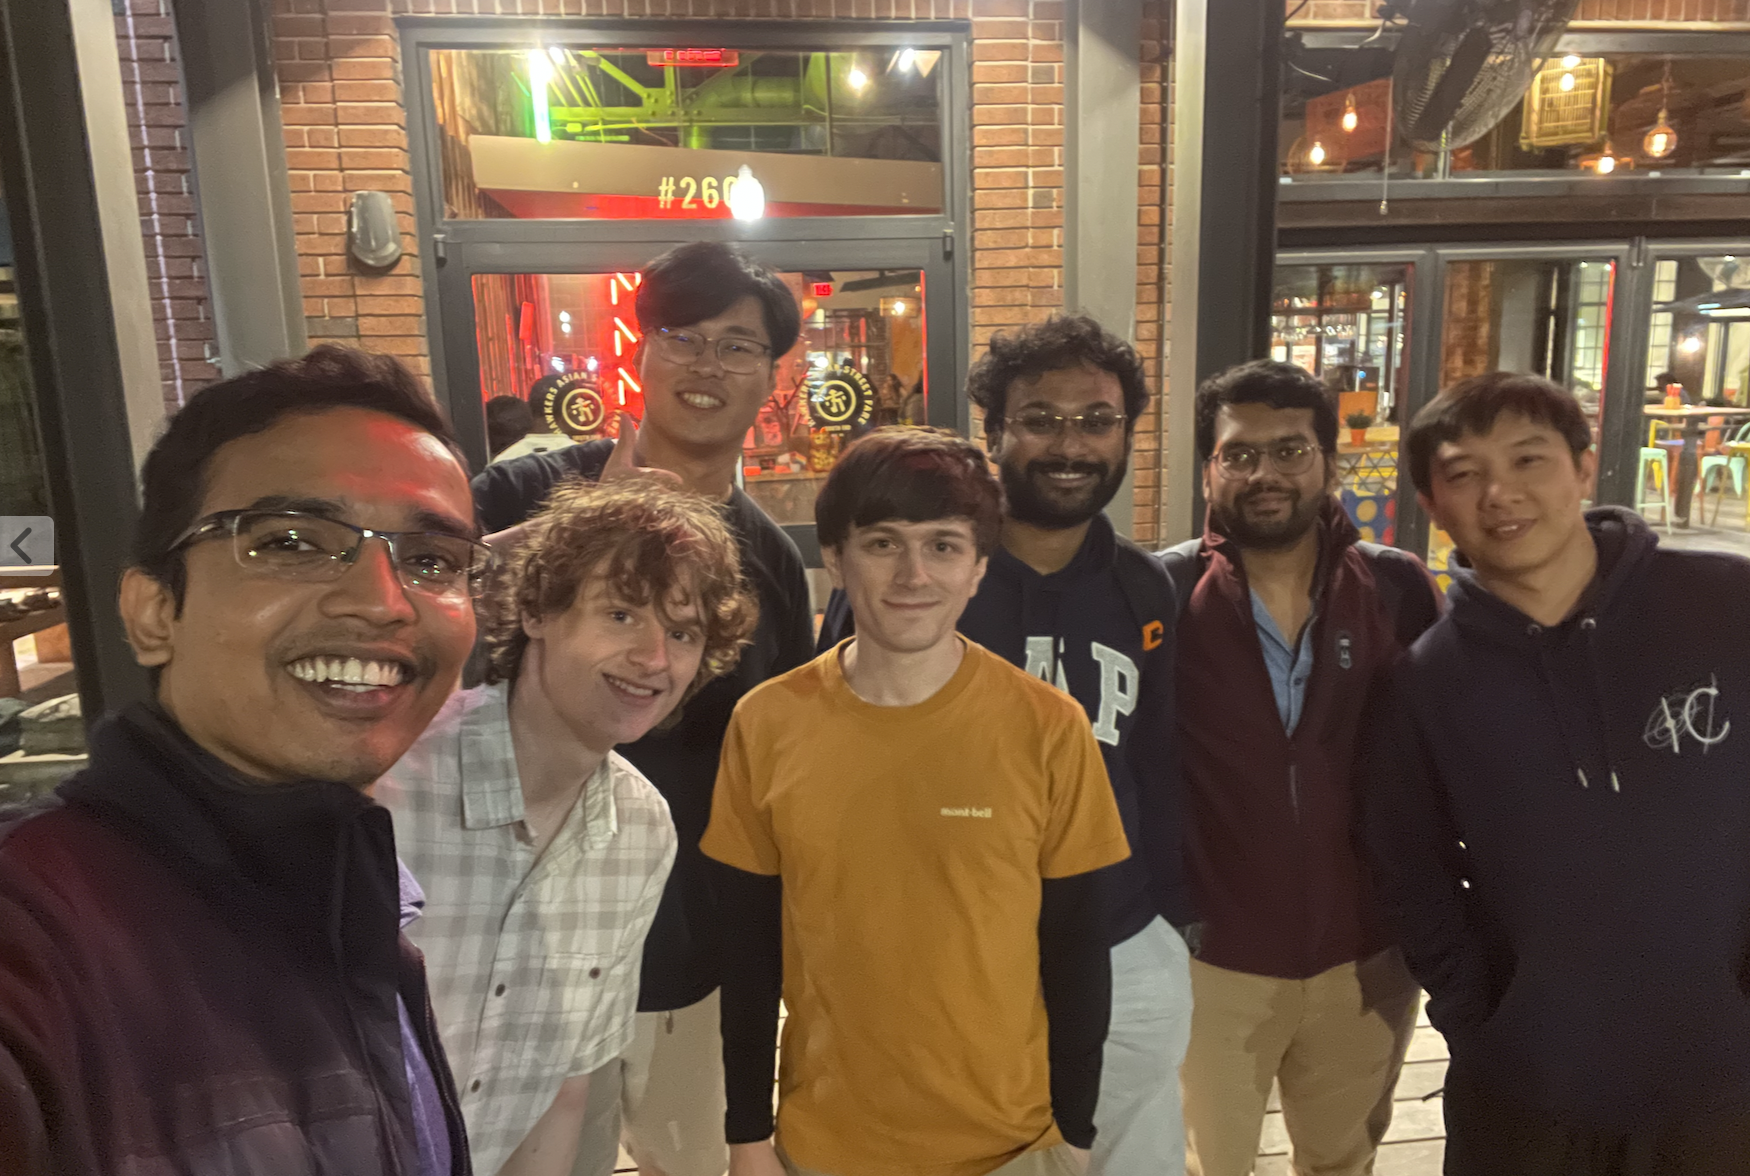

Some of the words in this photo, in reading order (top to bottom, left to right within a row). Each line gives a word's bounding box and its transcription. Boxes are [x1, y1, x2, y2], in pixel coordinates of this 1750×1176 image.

[556, 371, 588, 388] ASIAN
[843, 365, 873, 396] STREET
[1024, 636, 1140, 747] AP
